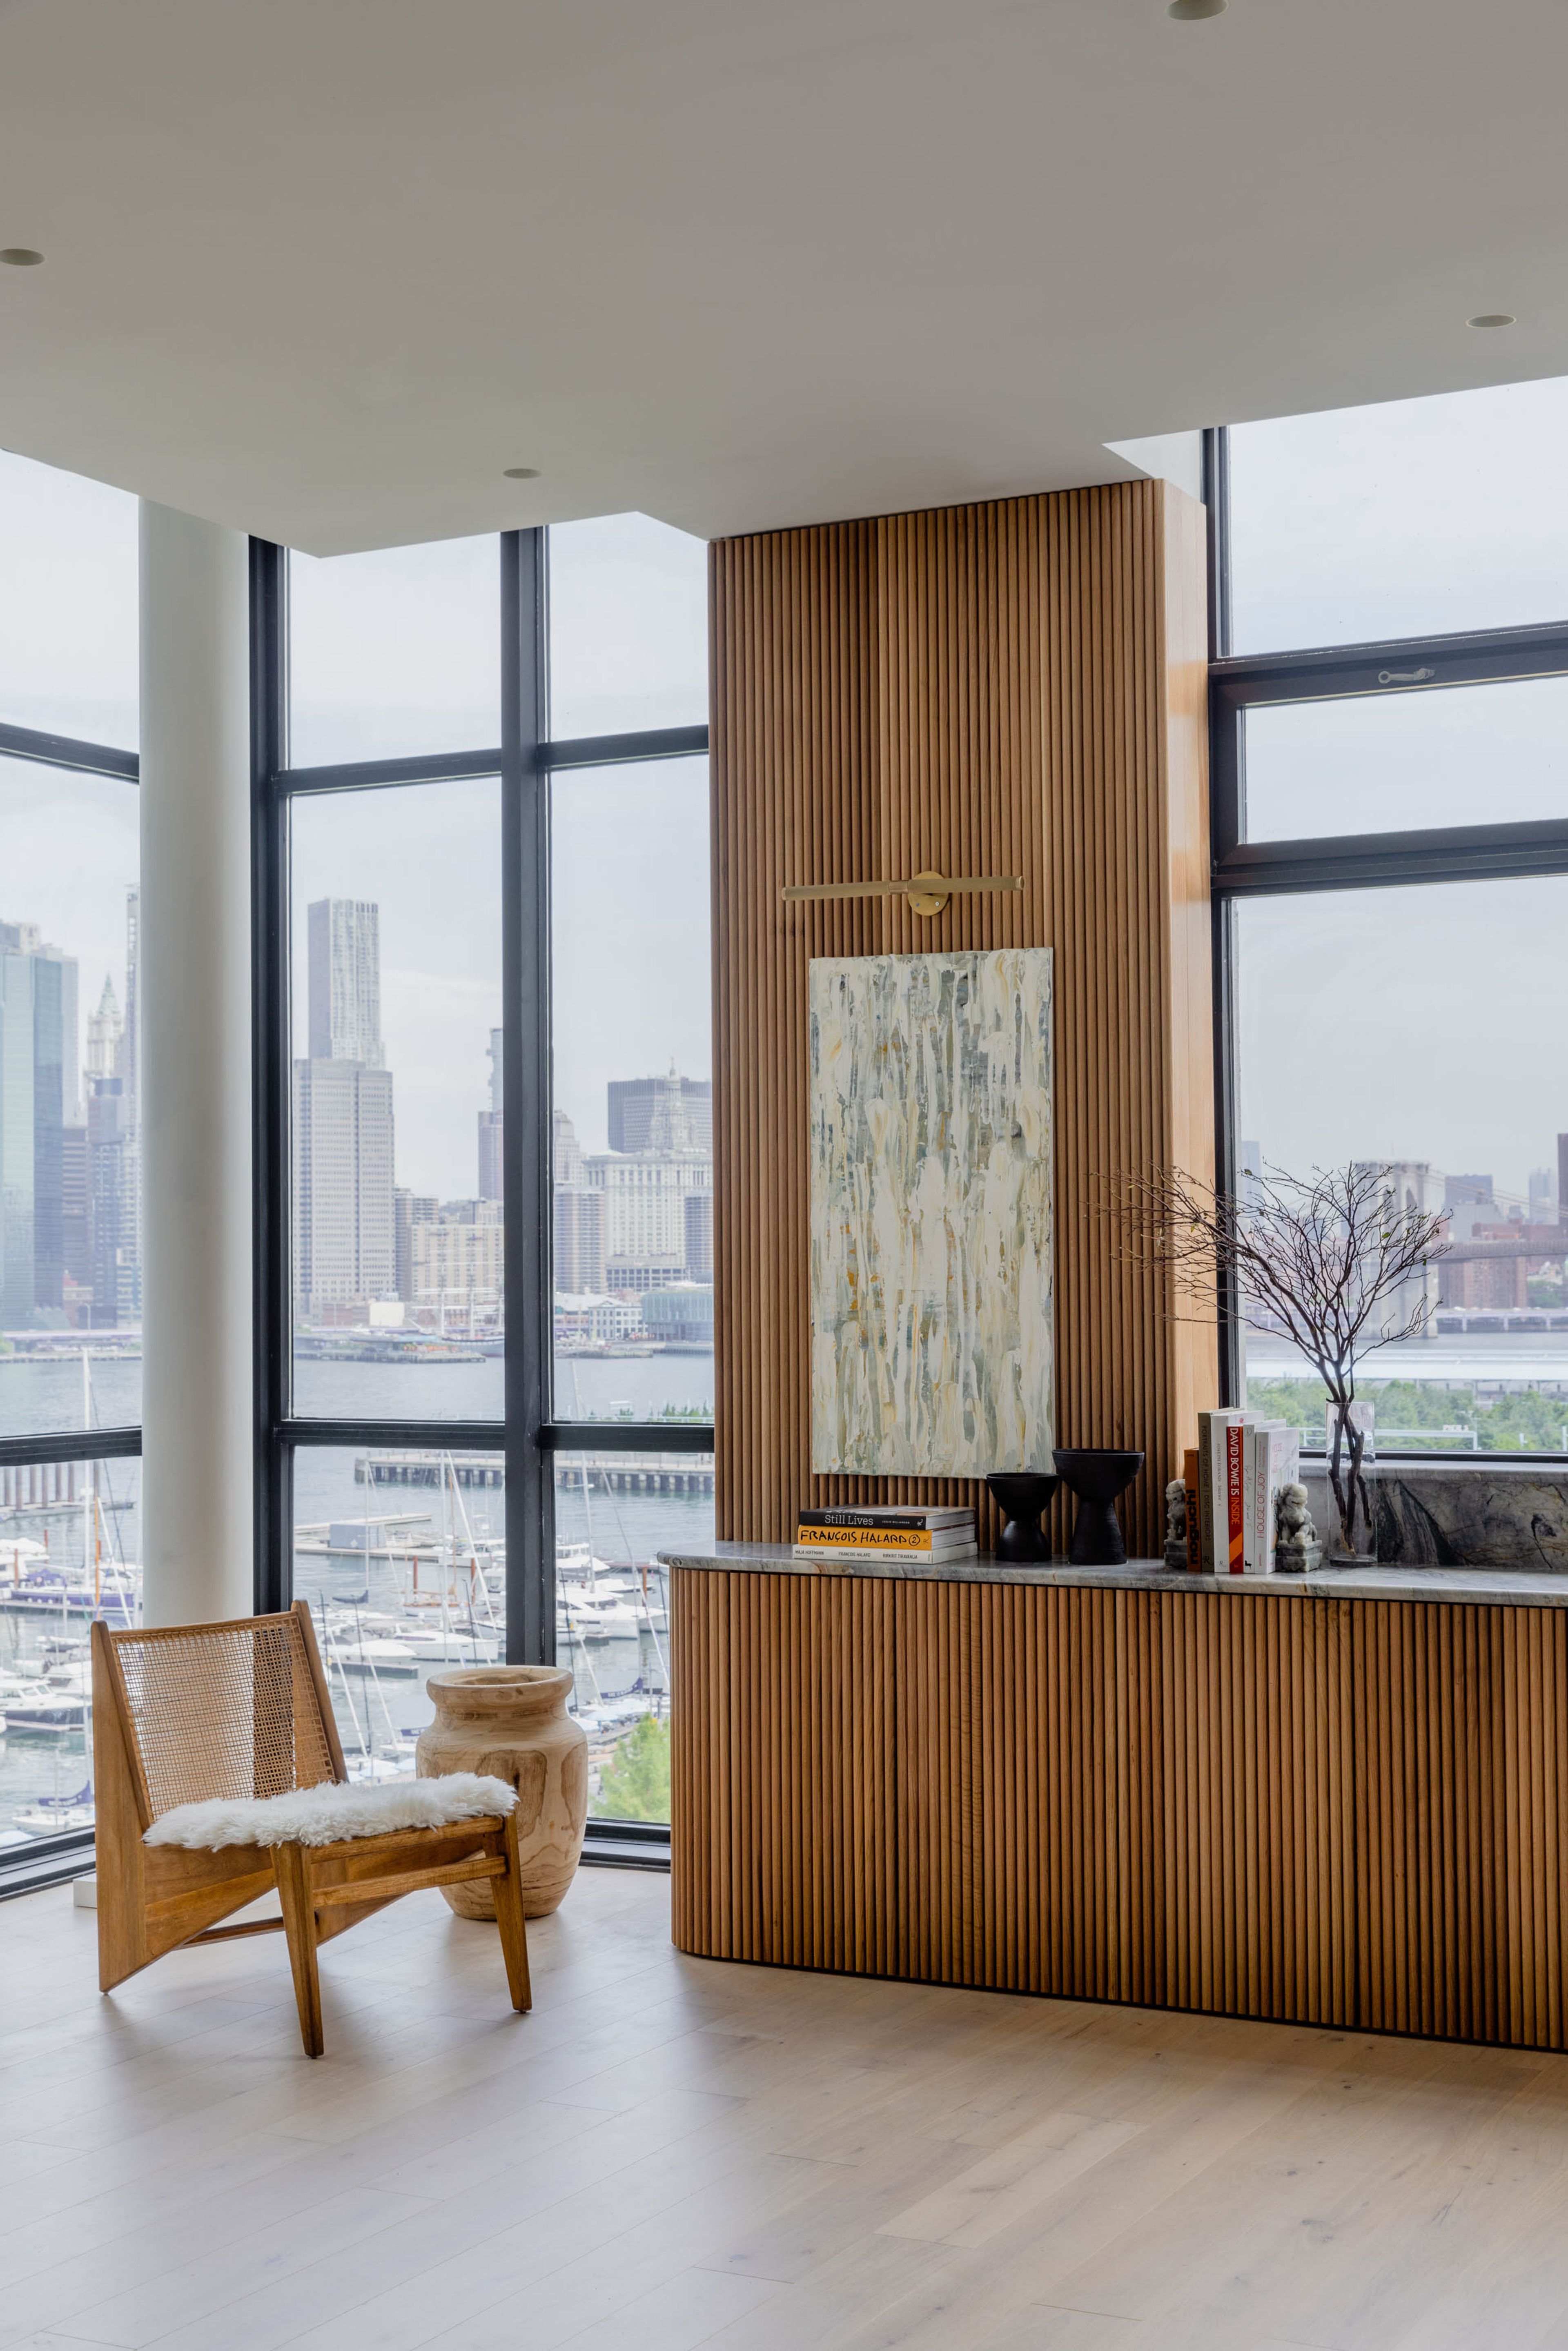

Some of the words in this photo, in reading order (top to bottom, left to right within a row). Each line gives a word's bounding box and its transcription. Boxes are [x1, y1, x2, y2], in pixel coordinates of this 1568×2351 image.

[1230, 1428, 1239, 1456] DAVID
[1203, 1458, 1209, 1467] OF
[1231, 1458, 1239, 1486] BOWIE
[1257, 1472, 1265, 1490] JOY
[1257, 1491, 1265, 1504] OF
[824, 1515, 845, 1524] Still
[848, 1516, 874, 1525] Lives
[1231, 1497, 1240, 1525] INSIDE
[1186, 1489, 1199, 1565] noguchi
[801, 1530, 857, 1543] FRANÇOIS
[860, 1532, 907, 1544] HALARD
